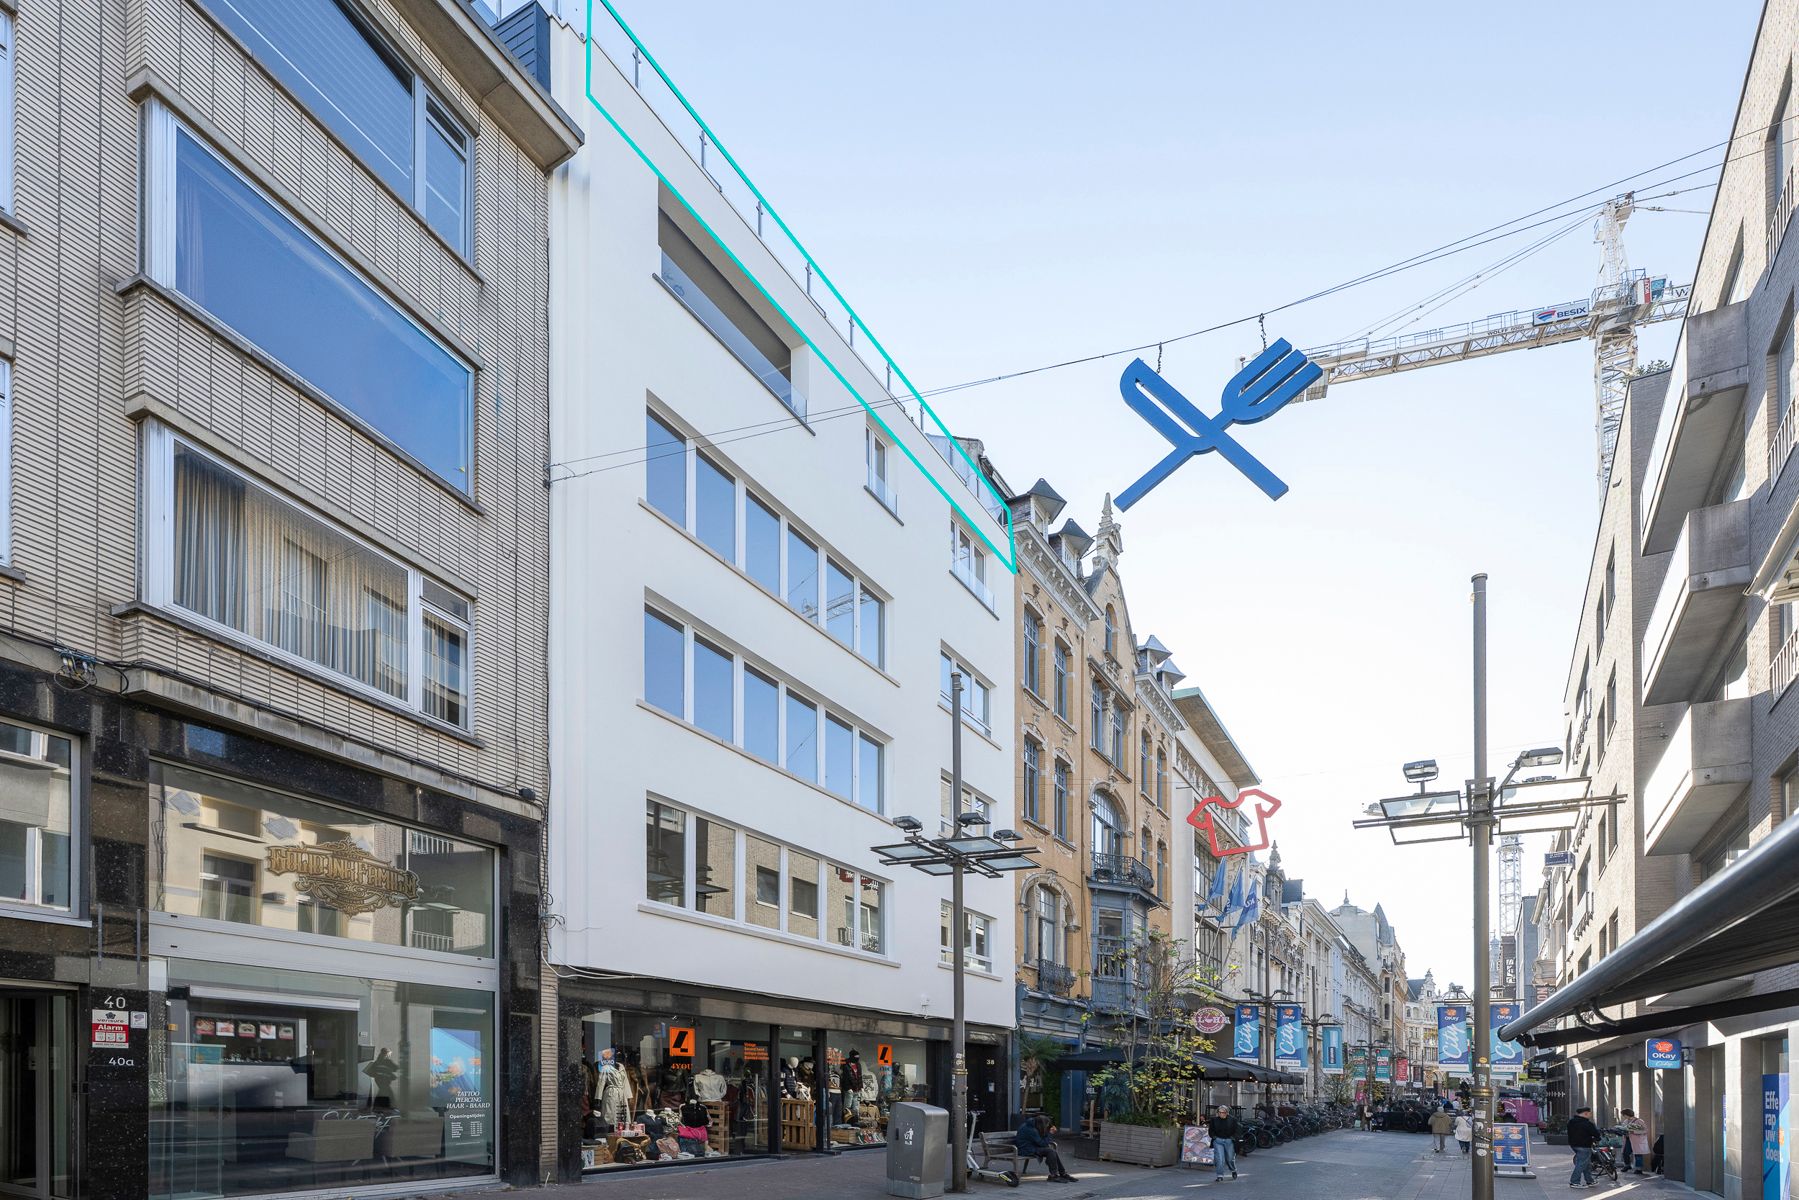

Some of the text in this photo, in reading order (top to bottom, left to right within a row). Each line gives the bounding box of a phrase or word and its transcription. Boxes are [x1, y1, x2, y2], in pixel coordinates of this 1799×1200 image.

[1557, 307, 1585, 318] BESIX
[104, 995, 126, 1009] 40
[1237, 1021, 1258, 1054] City
[1279, 1022, 1300, 1055] City
[1442, 1023, 1466, 1059] City
[109, 1057, 134, 1066] 40a
[1652, 1052, 1676, 1060] OKay
[1764, 1091, 1779, 1109] Effe
[1764, 1113, 1776, 1130] rap
[1765, 1129, 1776, 1142] uw
